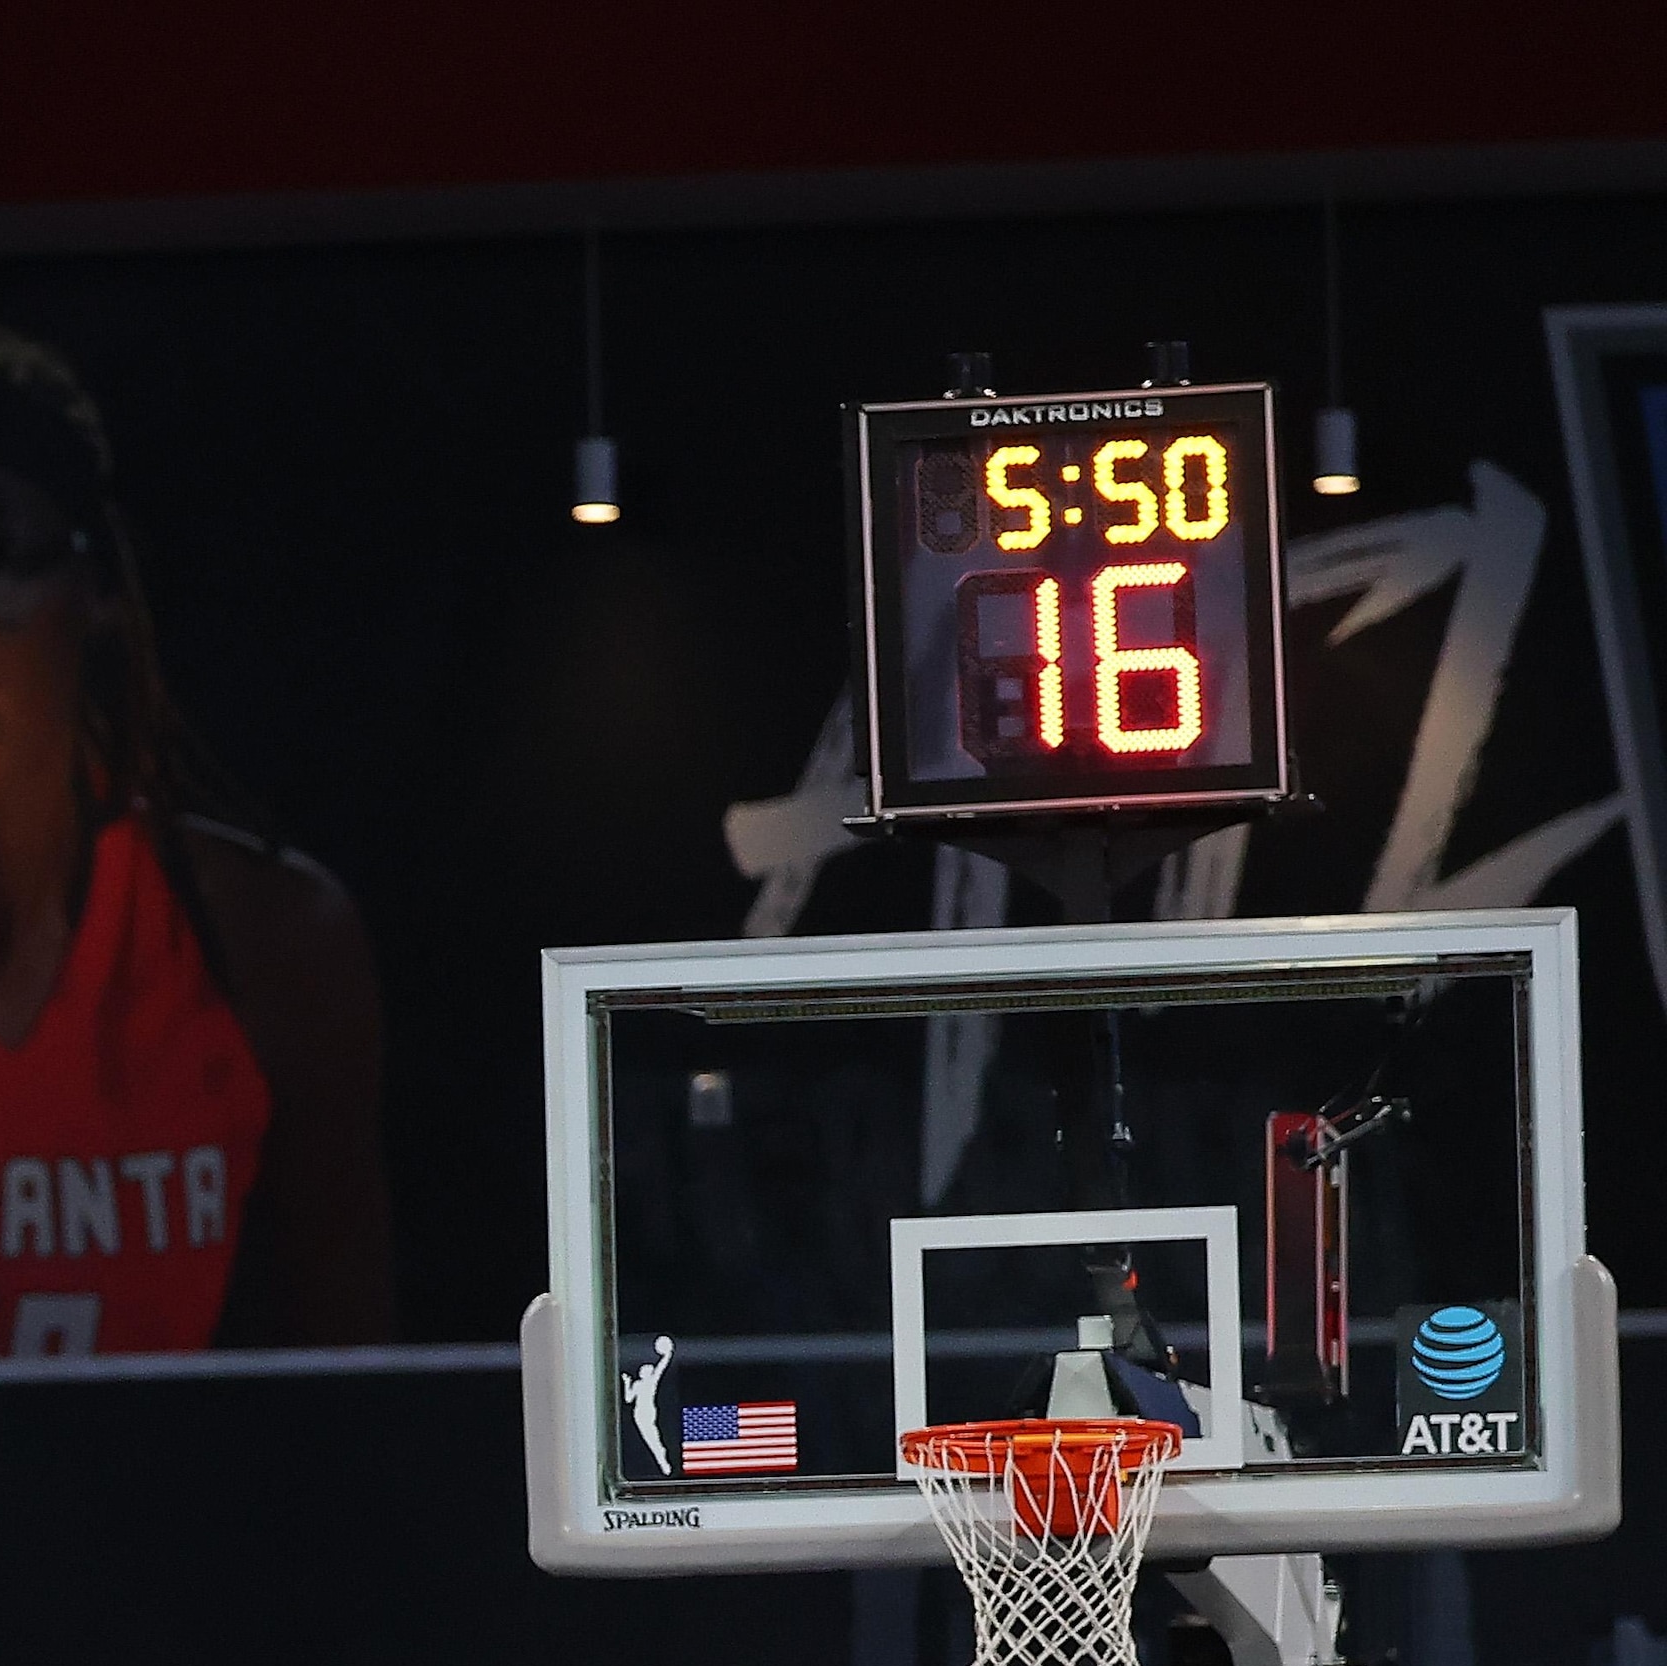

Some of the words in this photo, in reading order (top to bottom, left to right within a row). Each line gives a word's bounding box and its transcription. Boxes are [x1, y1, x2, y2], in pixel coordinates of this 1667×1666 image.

[969, 397, 1165, 428] DAKTRONICS
[985, 435, 1229, 551] 5:50
[1035, 561, 1202, 753] 16
[1401, 1412, 1518, 1455] AT&T
[604, 1506, 701, 1532] SPALDING
